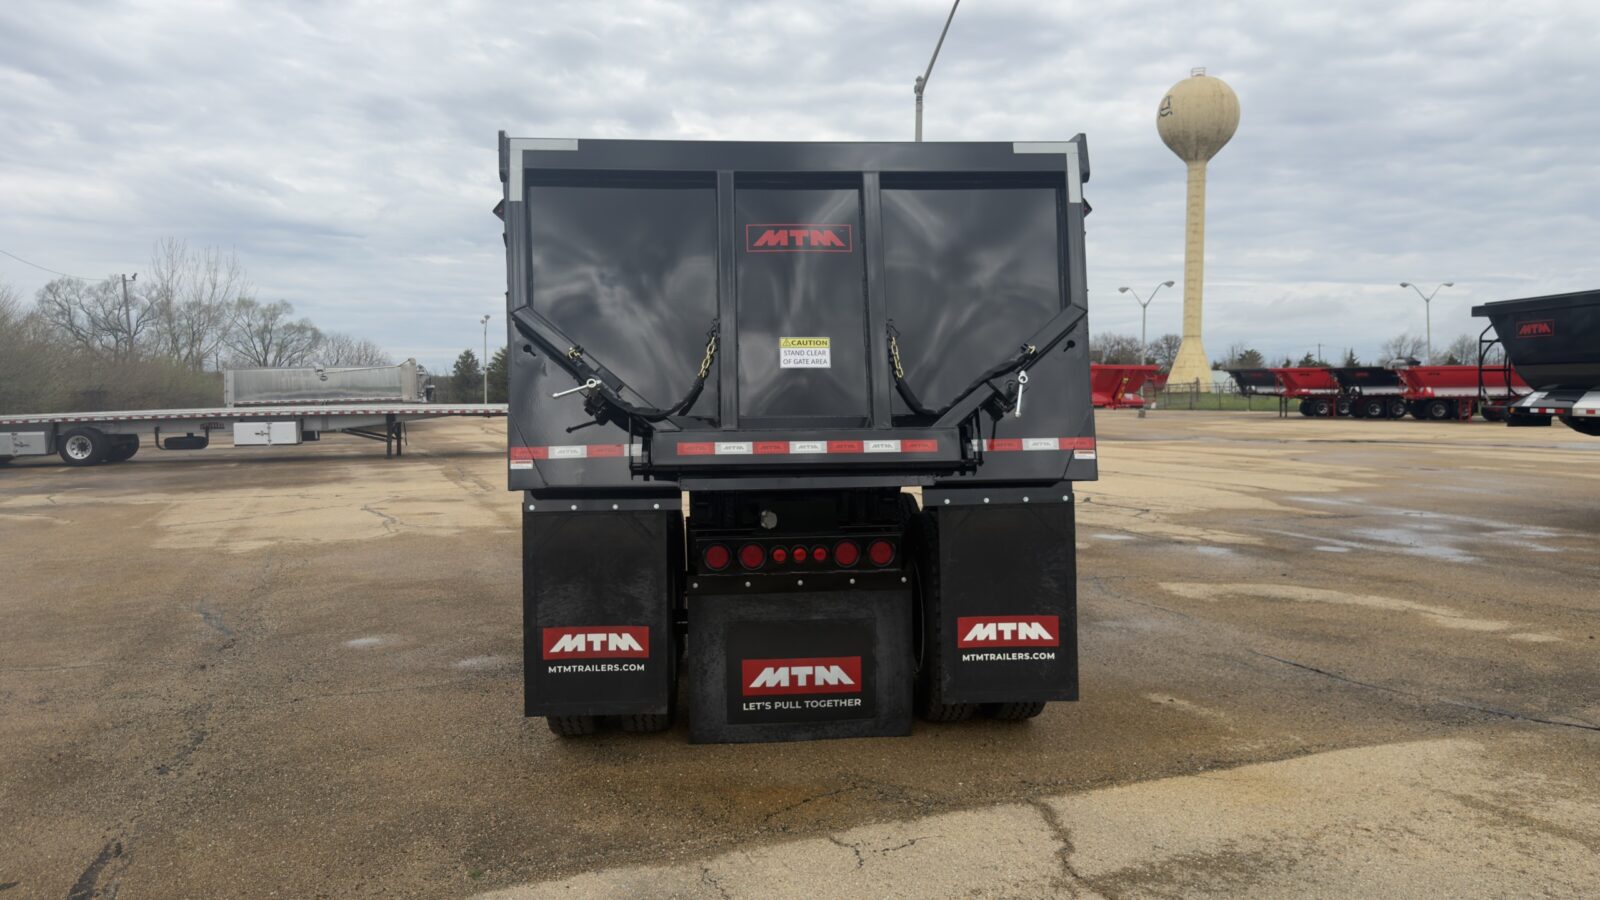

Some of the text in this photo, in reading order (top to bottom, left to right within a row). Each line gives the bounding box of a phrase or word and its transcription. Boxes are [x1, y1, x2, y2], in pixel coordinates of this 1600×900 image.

[752, 229, 846, 247] MTM
[1519, 322, 1551, 335] MTM
[791, 339, 829, 347] CAUTION
[962, 622, 1054, 642] MTM
[549, 633, 644, 653] MTM
[962, 652, 1055, 661] MTMTRAILERS.COM
[548, 664, 645, 673] MTMTRAILERS.COM
[749, 665, 856, 688] MTM
[743, 698, 861, 711] LET'S PULL TOGETHER
